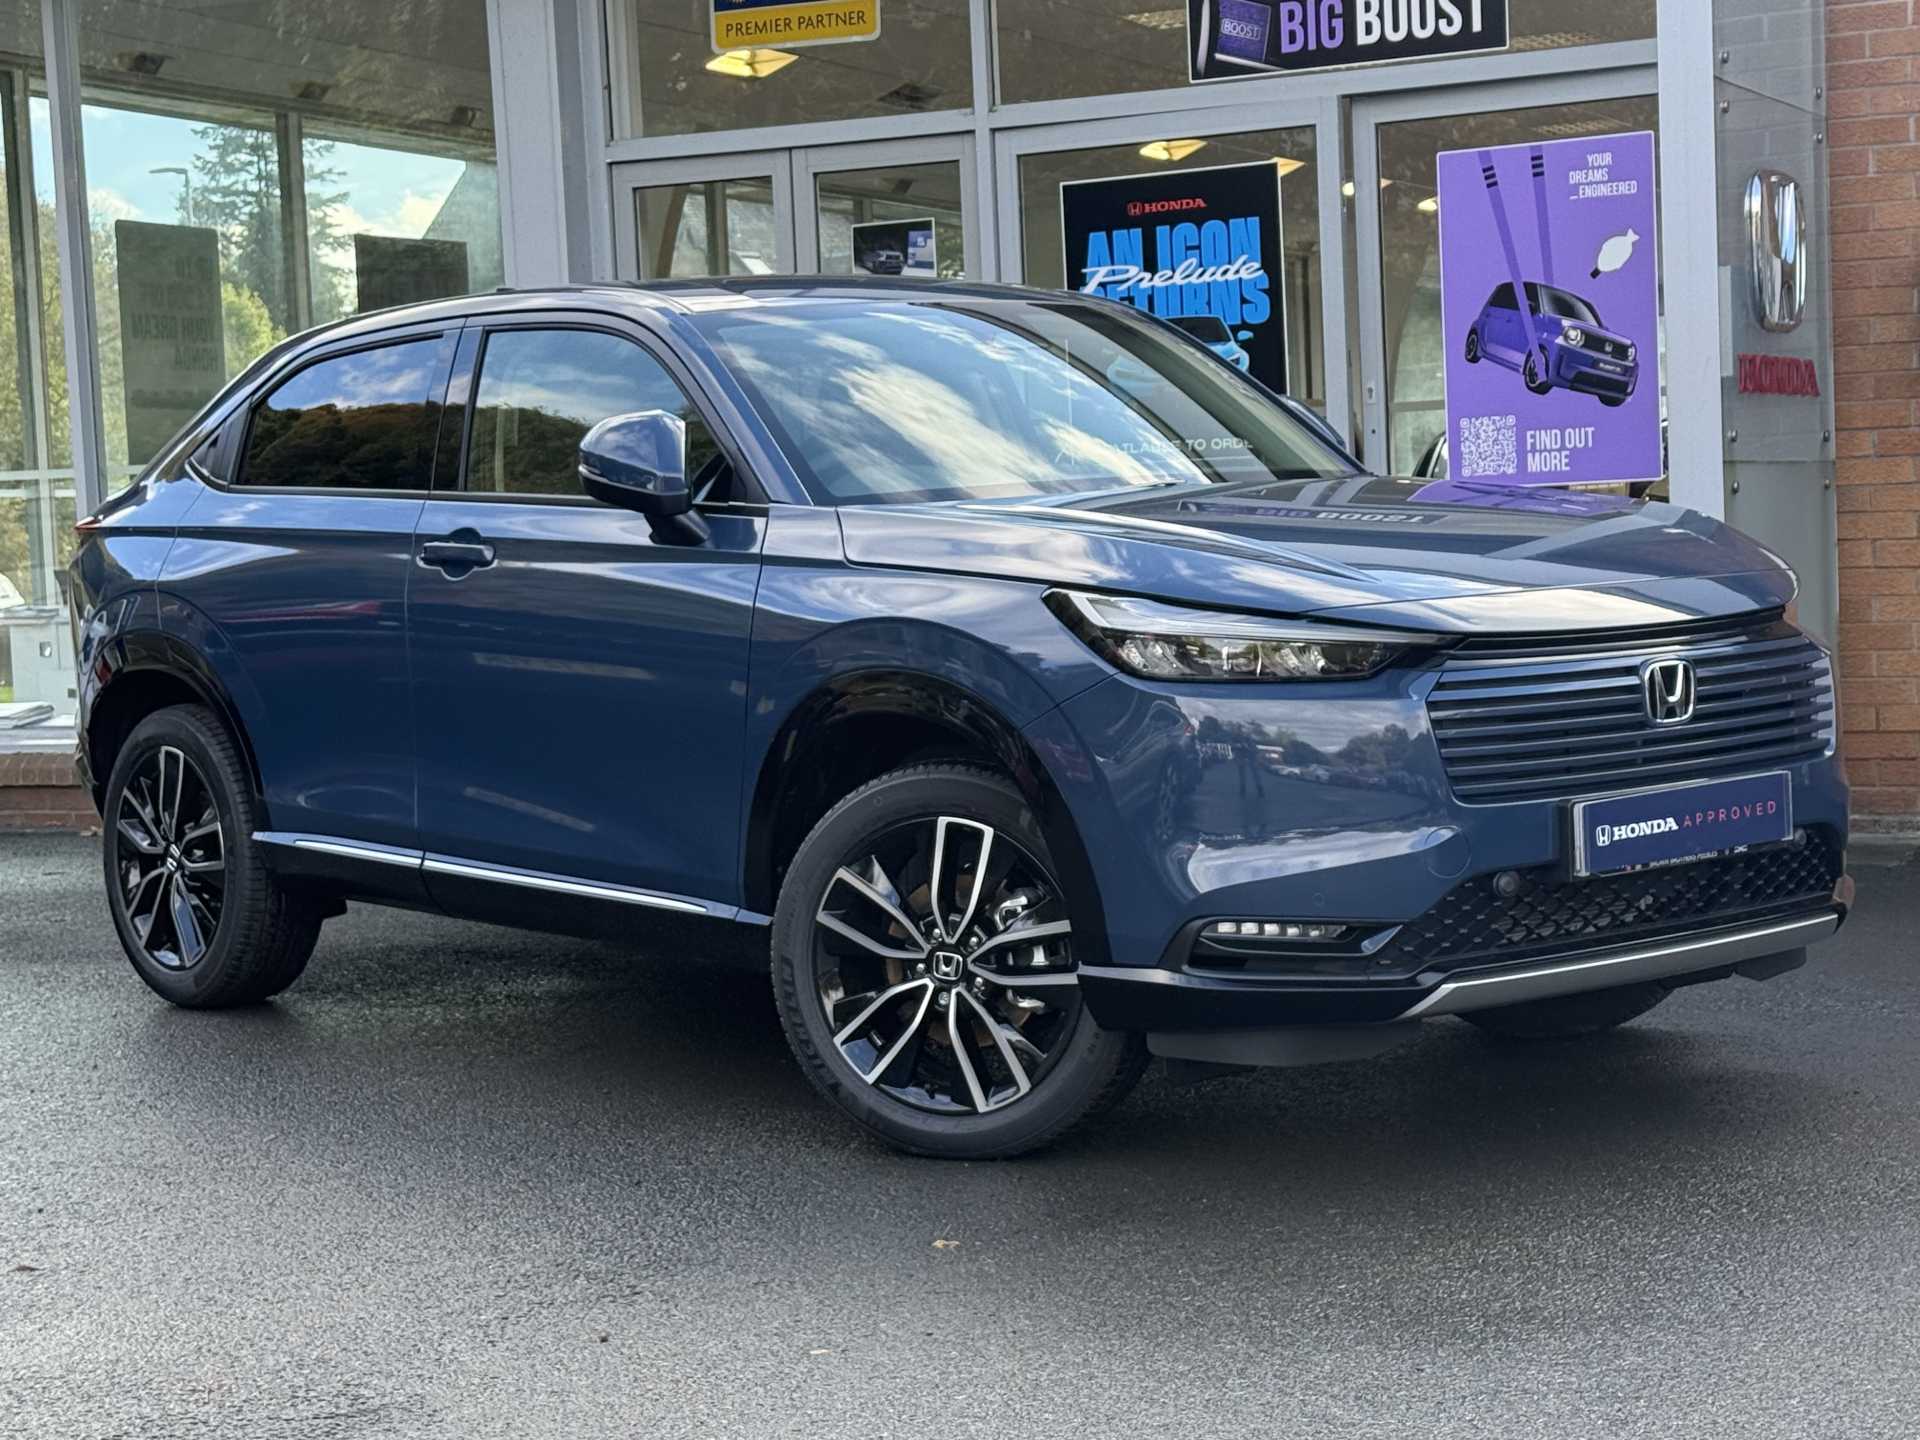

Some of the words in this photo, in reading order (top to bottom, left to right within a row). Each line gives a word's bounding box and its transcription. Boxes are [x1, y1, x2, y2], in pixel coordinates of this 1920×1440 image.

[725, 17, 793, 38] PREMIER
[797, 10, 866, 30] PARTNER
[1224, 21, 1260, 37] BOOST
[1280, 0, 1344, 54] BIG
[1586, 152, 1613, 167] YOUR
[1569, 167, 1609, 184] DREAMS
[1144, 199, 1207, 214] HONDA
[1086, 228, 1144, 285] AN
[1156, 216, 1262, 280] ICON
[1081, 254, 1265, 293] Prelude
[1185, 438, 1206, 451] TO
[1526, 429, 1561, 450] FIND
[1565, 426, 1595, 448] OUT
[1527, 450, 1570, 472] MORE
[1612, 816, 1679, 841] HONDA
[1683, 800, 1777, 828] APPROVED
